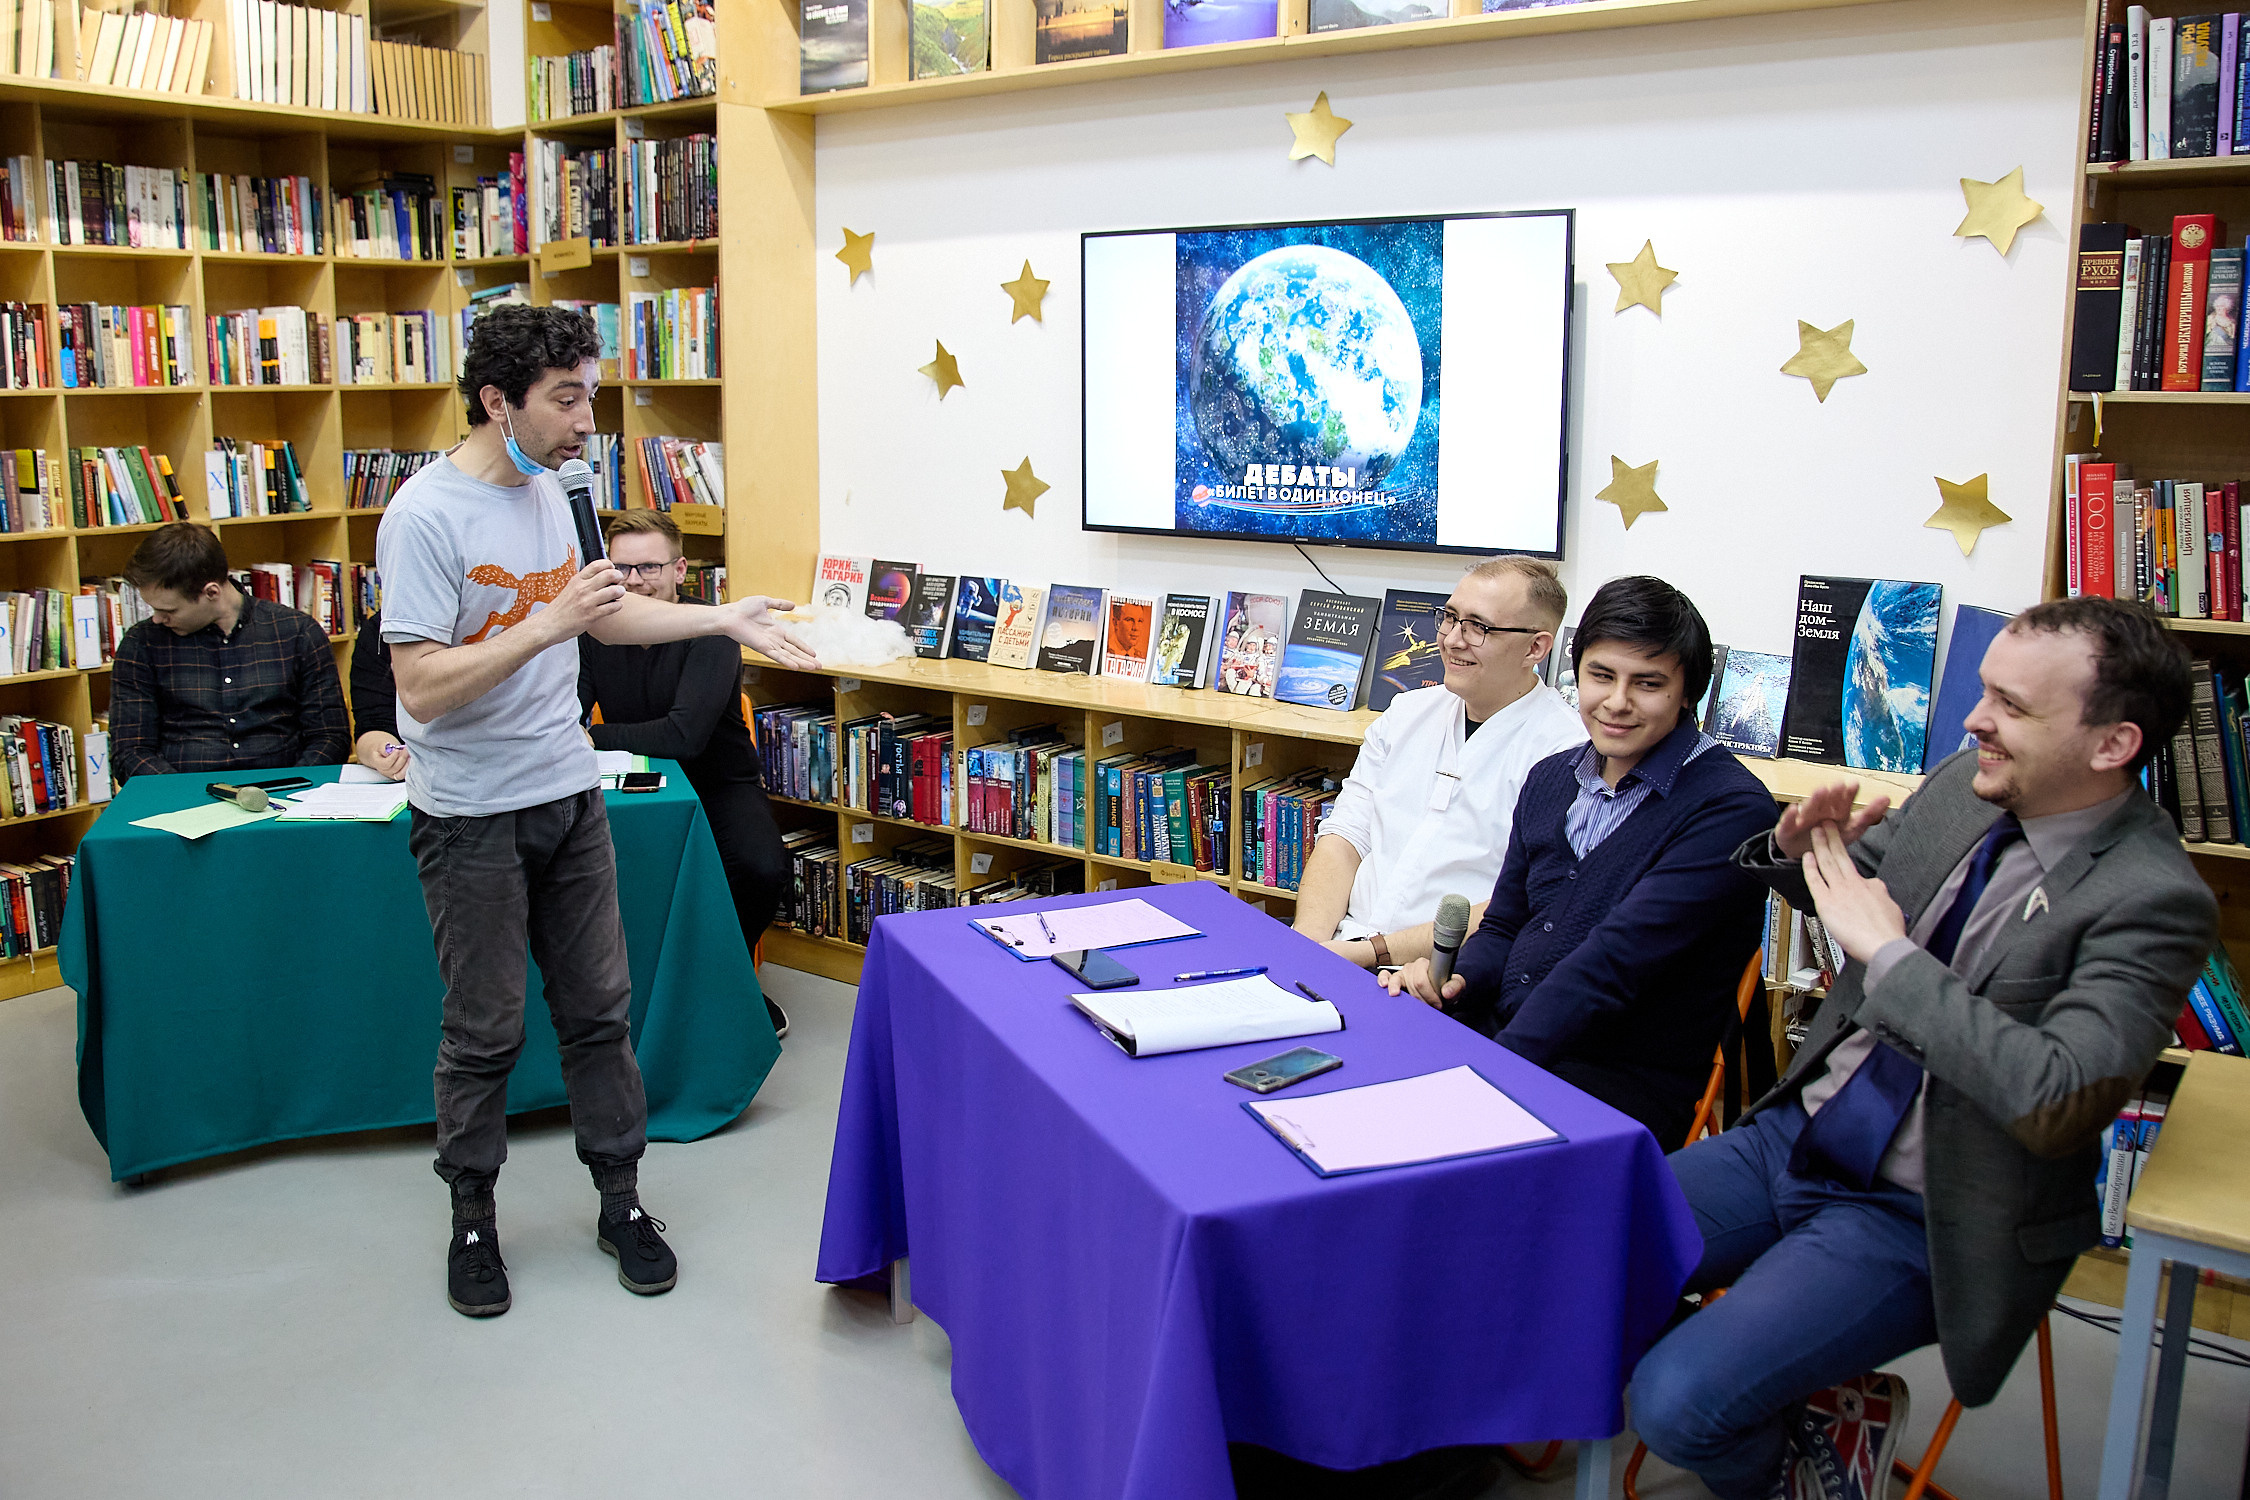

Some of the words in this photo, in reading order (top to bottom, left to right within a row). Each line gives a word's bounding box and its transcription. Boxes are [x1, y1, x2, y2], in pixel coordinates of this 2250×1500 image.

[2182, 24, 2196, 55] ИГРЫ
[2196, 21, 2211, 67] РАЗУМА
[2096, 73, 2102, 81] НА
[2107, 49, 2117, 95] Суперобъекты
[2091, 108, 2099, 141] ВРЕМЕНИ
[2081, 265, 2119, 276] РУСЬ
[2178, 292, 2193, 344] ЕКАТЕРИНЫ
[2178, 344, 2189, 374] ИСТОРИЯ
[38, 453, 46, 478] ТИМ
[1243, 463, 1356, 488] ДЕБАТЫ
[1207, 484, 1266, 500] «БИЛЕТ
[1268, 488, 1279, 500] В
[1279, 488, 1328, 504] ОДИН
[1327, 490, 1397, 508] КОНЕЦ»
[41, 485, 52, 529] ПАУЭРС
[2087, 492, 2106, 530] 100
[2183, 488, 2194, 556] Цивилизация
[2093, 531, 2099, 544] ИЗ
[823, 557, 852, 571] ЮРИЙ
[821, 569, 864, 584] ГАГАРИН
[1176, 609, 1206, 618] КОСМОСЕ
[1310, 601, 1330, 609] СЕРГЕЙ
[1332, 604, 1365, 614] РЯЗАНСКИЙ
[1314, 611, 1356, 621] УДИВИТЕЛЬНАЯ
[1801, 599, 1833, 614] Наш
[78, 617, 94, 639] Т
[913, 628, 938, 638] ЧЕЛОВЕК
[997, 627, 1032, 638] ПАССАЖИР
[1304, 616, 1360, 637] ЗЕМЛЯ
[1797, 624, 1840, 640] Земля
[914, 637, 938, 646] КОСМОСЕ
[998, 636, 1003, 644] С
[1003, 636, 1029, 647] ДЕТЬМИ
[1106, 658, 1145, 678] ГАГАРИН
[1421, 679, 1438, 687] УТРО
[894, 742, 906, 775] ГОСТЬЯ
[1152, 814, 1161, 859] АНДРОНАТИ
[1160, 814, 1169, 859] ЛАЗАРЧУК
[2204, 1008, 2225, 1041] РАЗУМА
[2108, 1152, 2126, 1215] Великобритании
[2105, 1221, 2116, 1234] Все
